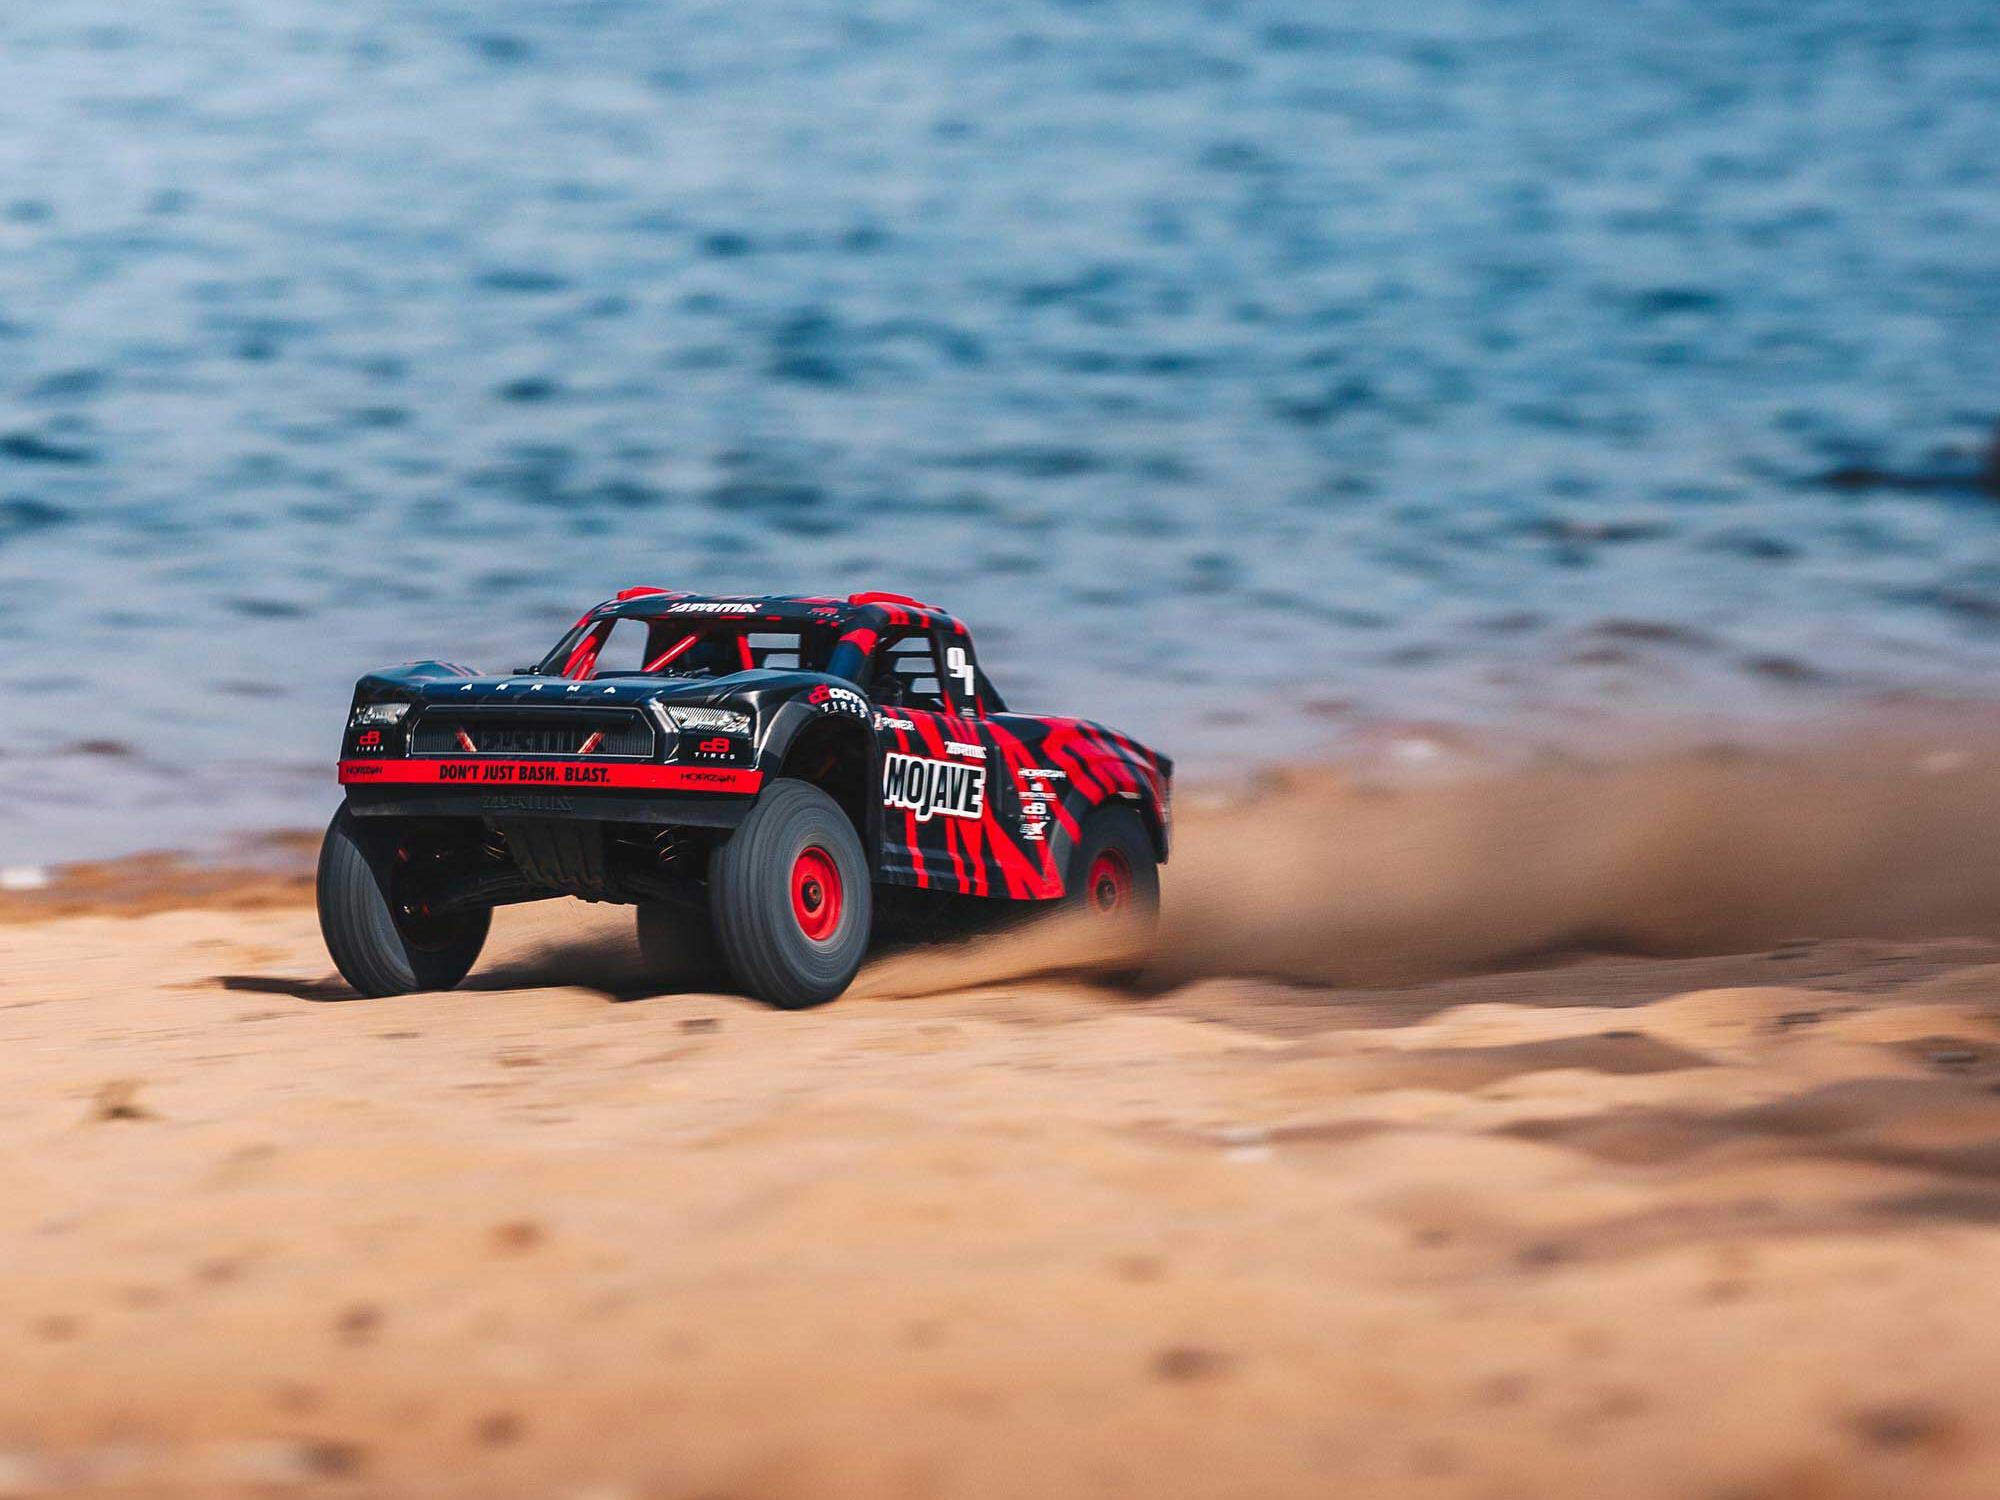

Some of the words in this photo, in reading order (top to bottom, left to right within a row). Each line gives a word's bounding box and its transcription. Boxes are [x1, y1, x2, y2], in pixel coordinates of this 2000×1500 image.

[947, 647, 975, 695] 91
[821, 701, 866, 718] TIRES
[694, 751, 736, 760] TIRES
[439, 764, 479, 780] DON'T
[482, 766, 515, 780] JUST
[518, 766, 559, 781] BASH.
[564, 767, 611, 783] BLAST.
[680, 772, 736, 784] HORIZON
[883, 754, 986, 821] MOJAVE
